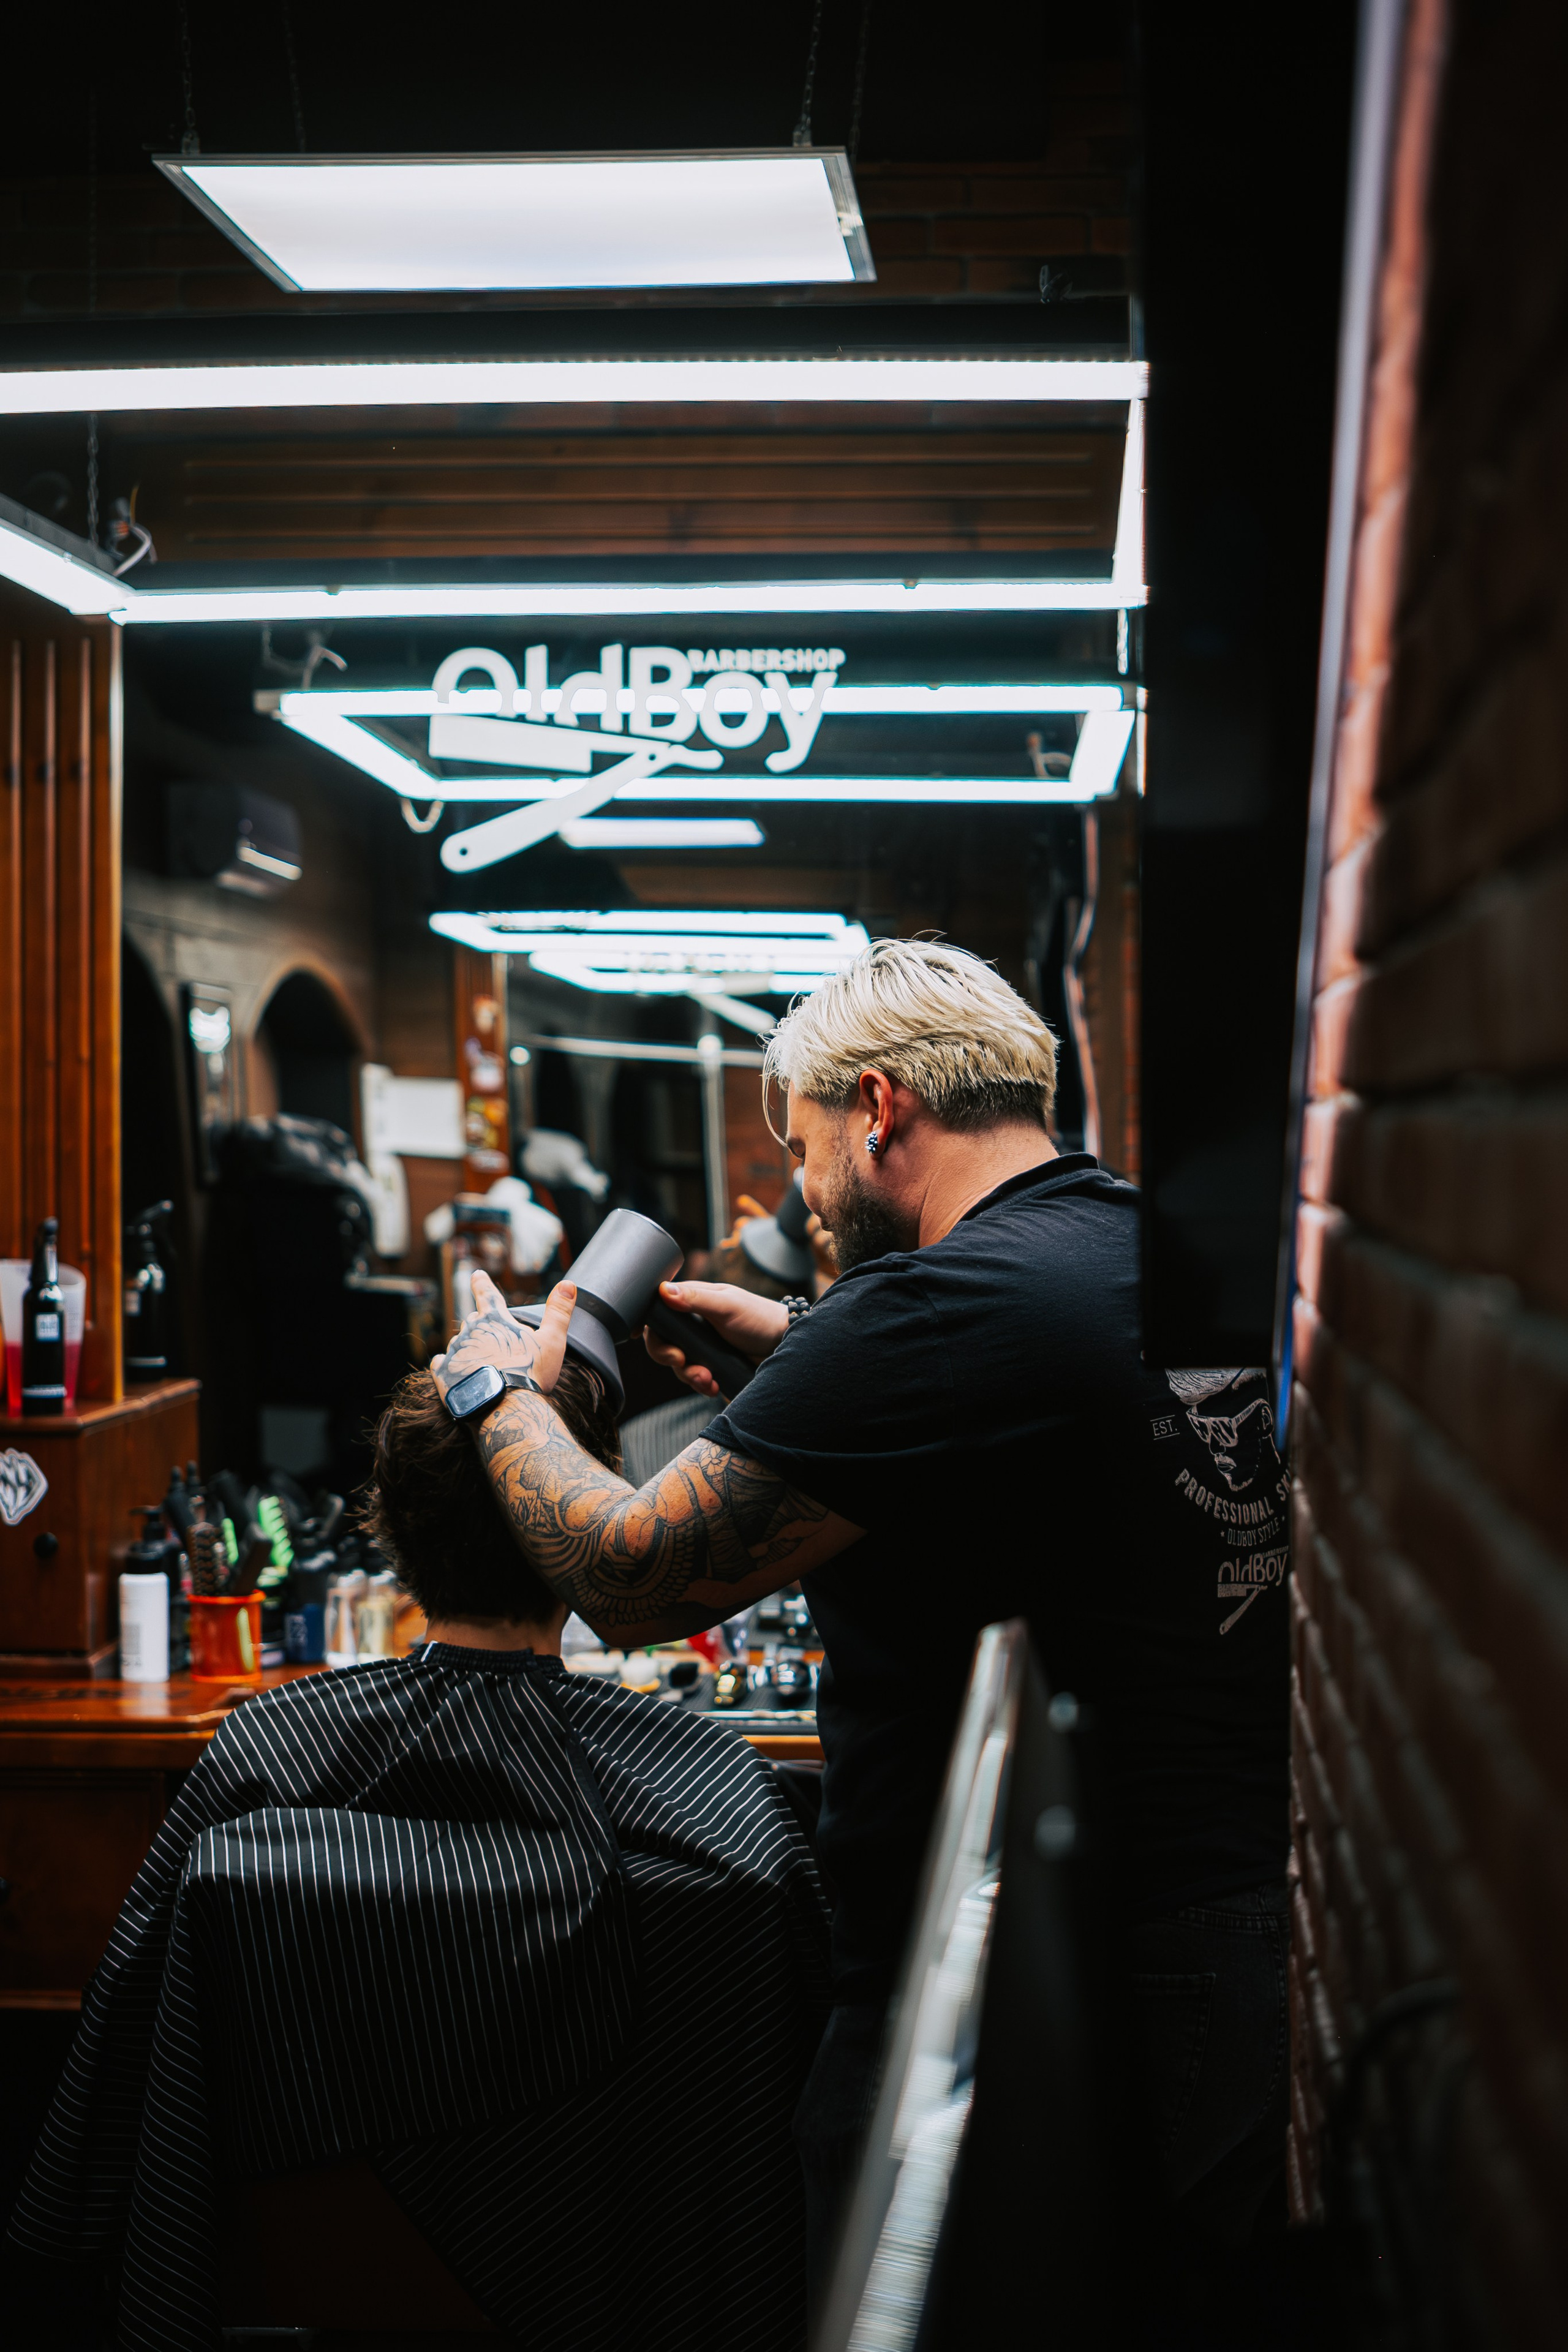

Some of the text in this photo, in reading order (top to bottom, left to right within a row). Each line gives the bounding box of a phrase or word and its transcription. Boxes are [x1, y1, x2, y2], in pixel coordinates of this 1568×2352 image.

[687, 647, 846, 673] BARBERSHOP
[431, 644, 837, 774] OldBoy
[1153, 1419, 1178, 1436] EST.
[1175, 1468, 1275, 1525] PROFESSIONAL
[1227, 1517, 1280, 1547] OLDBOY STYLE
